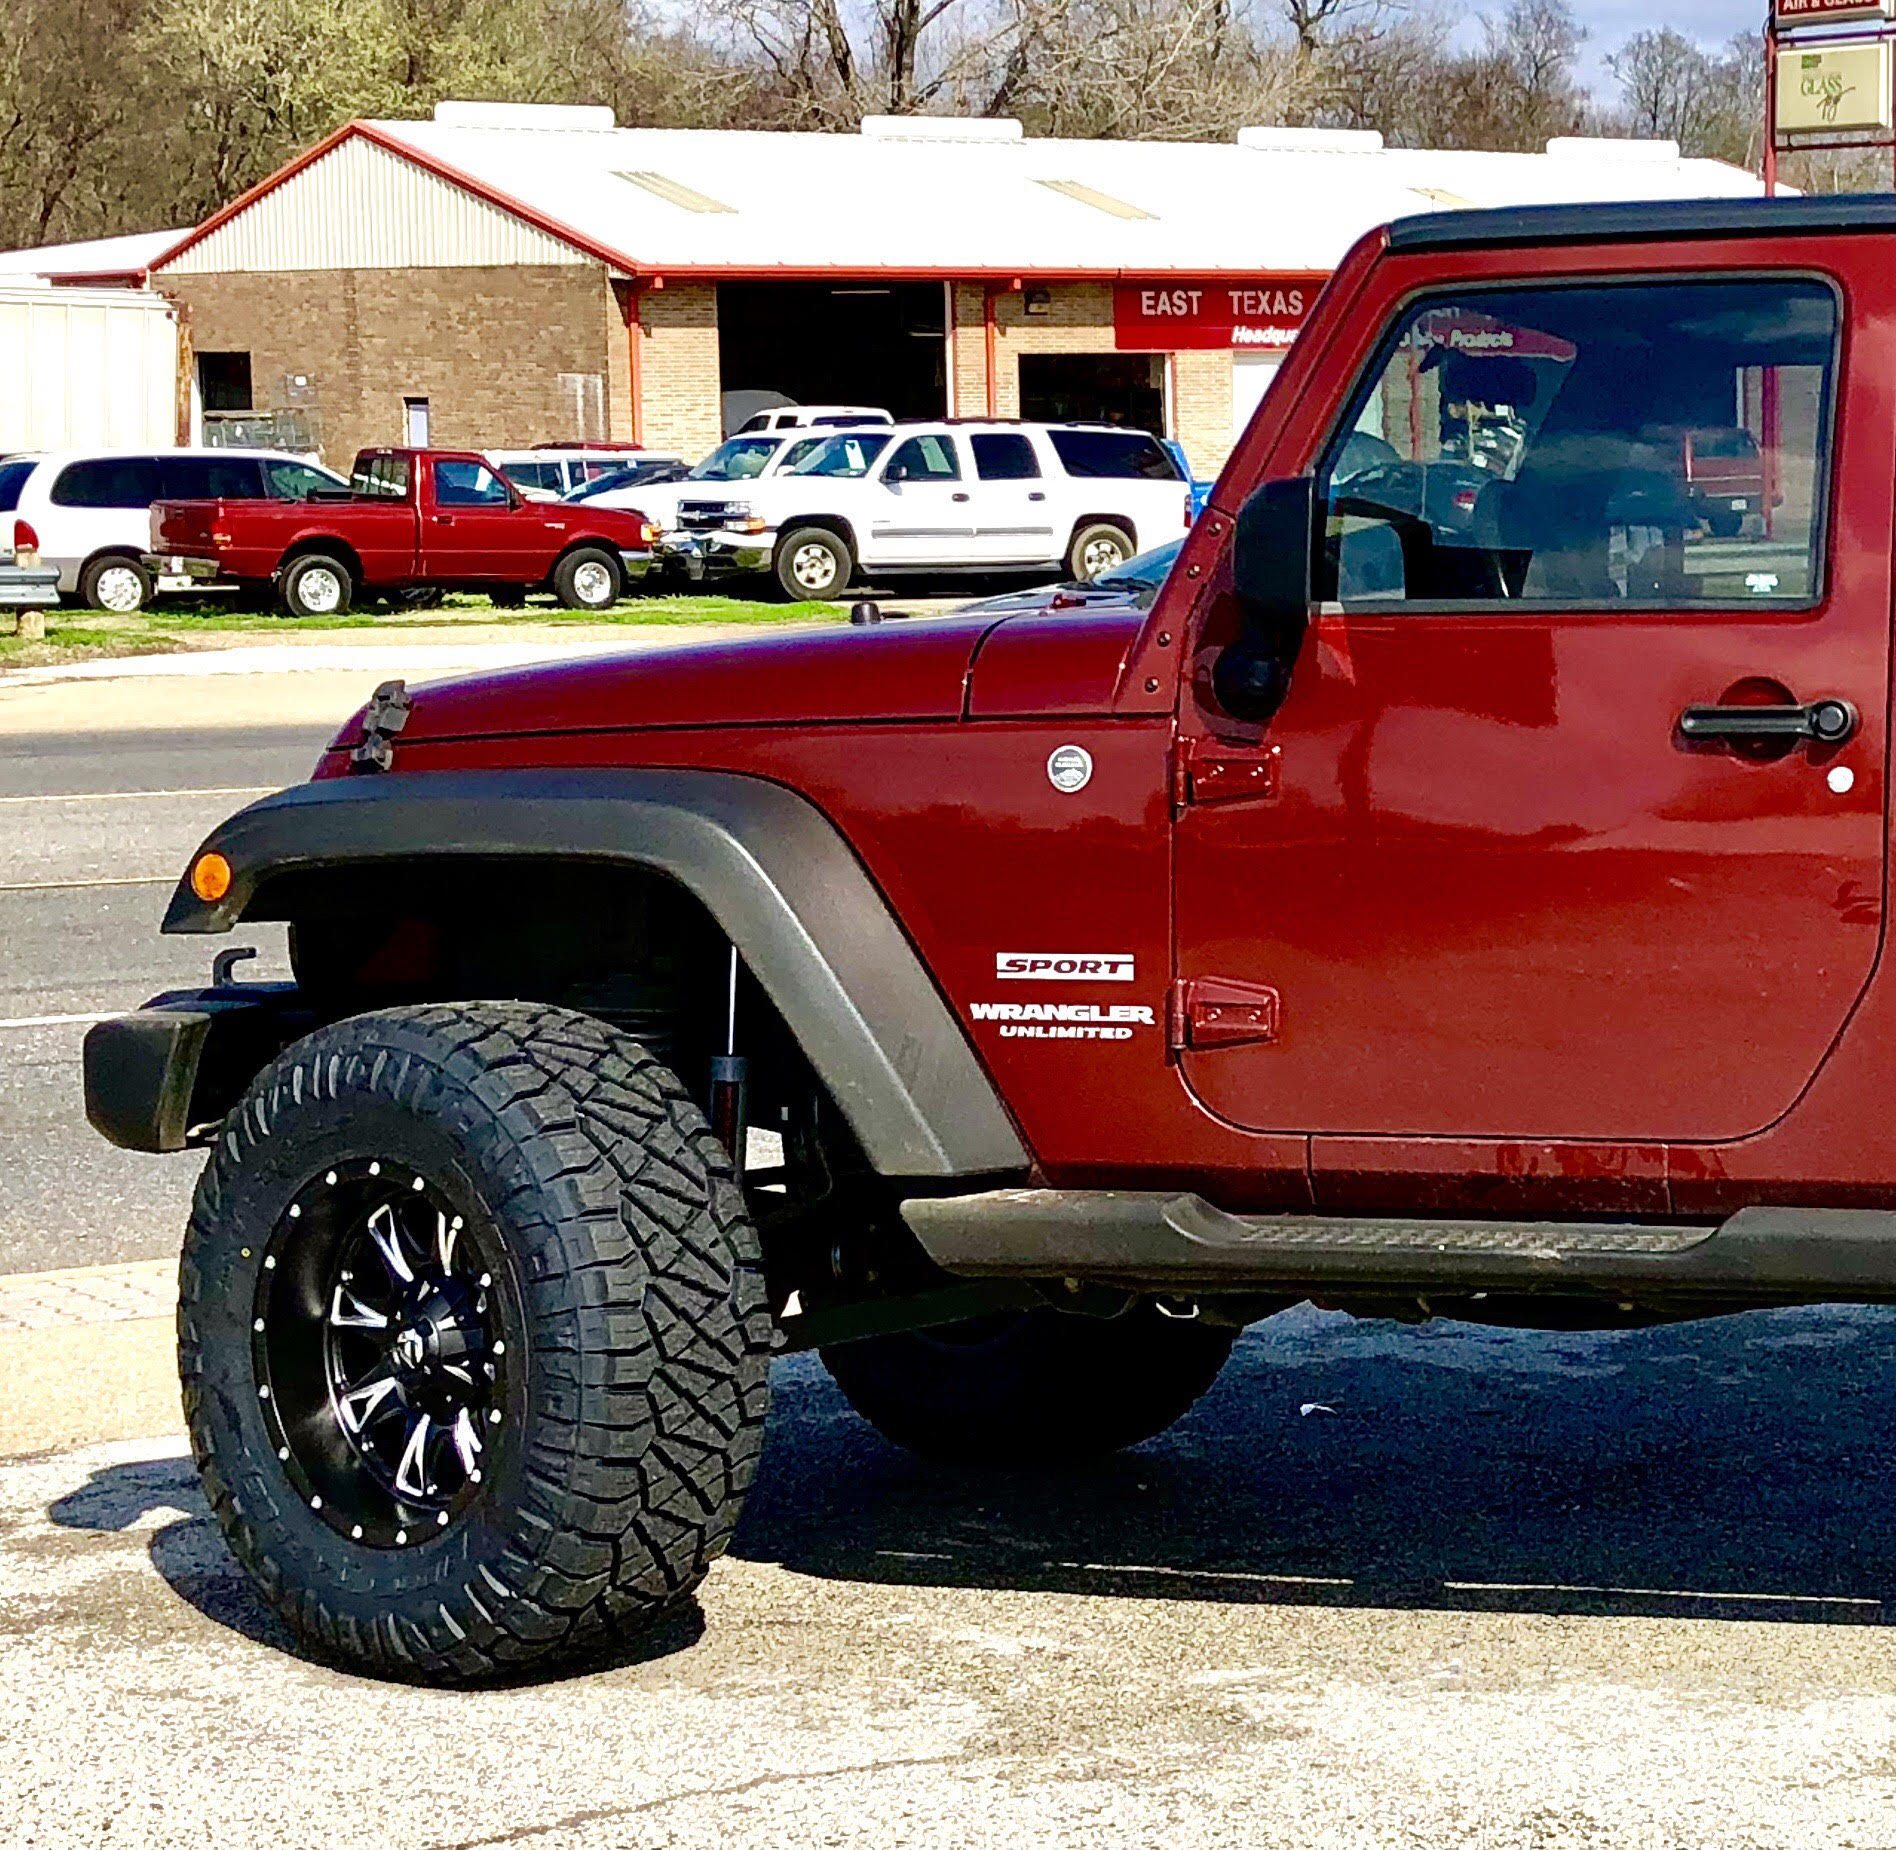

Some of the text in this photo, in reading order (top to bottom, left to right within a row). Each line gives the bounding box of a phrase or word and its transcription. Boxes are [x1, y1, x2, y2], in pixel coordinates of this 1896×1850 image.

[1141, 290, 1303, 316] EAST TEXAS
[1005, 959, 1120, 974] SPORT
[970, 1003, 1155, 1024] WRANGLER
[1000, 1025, 1132, 1039] UNLIMITED
